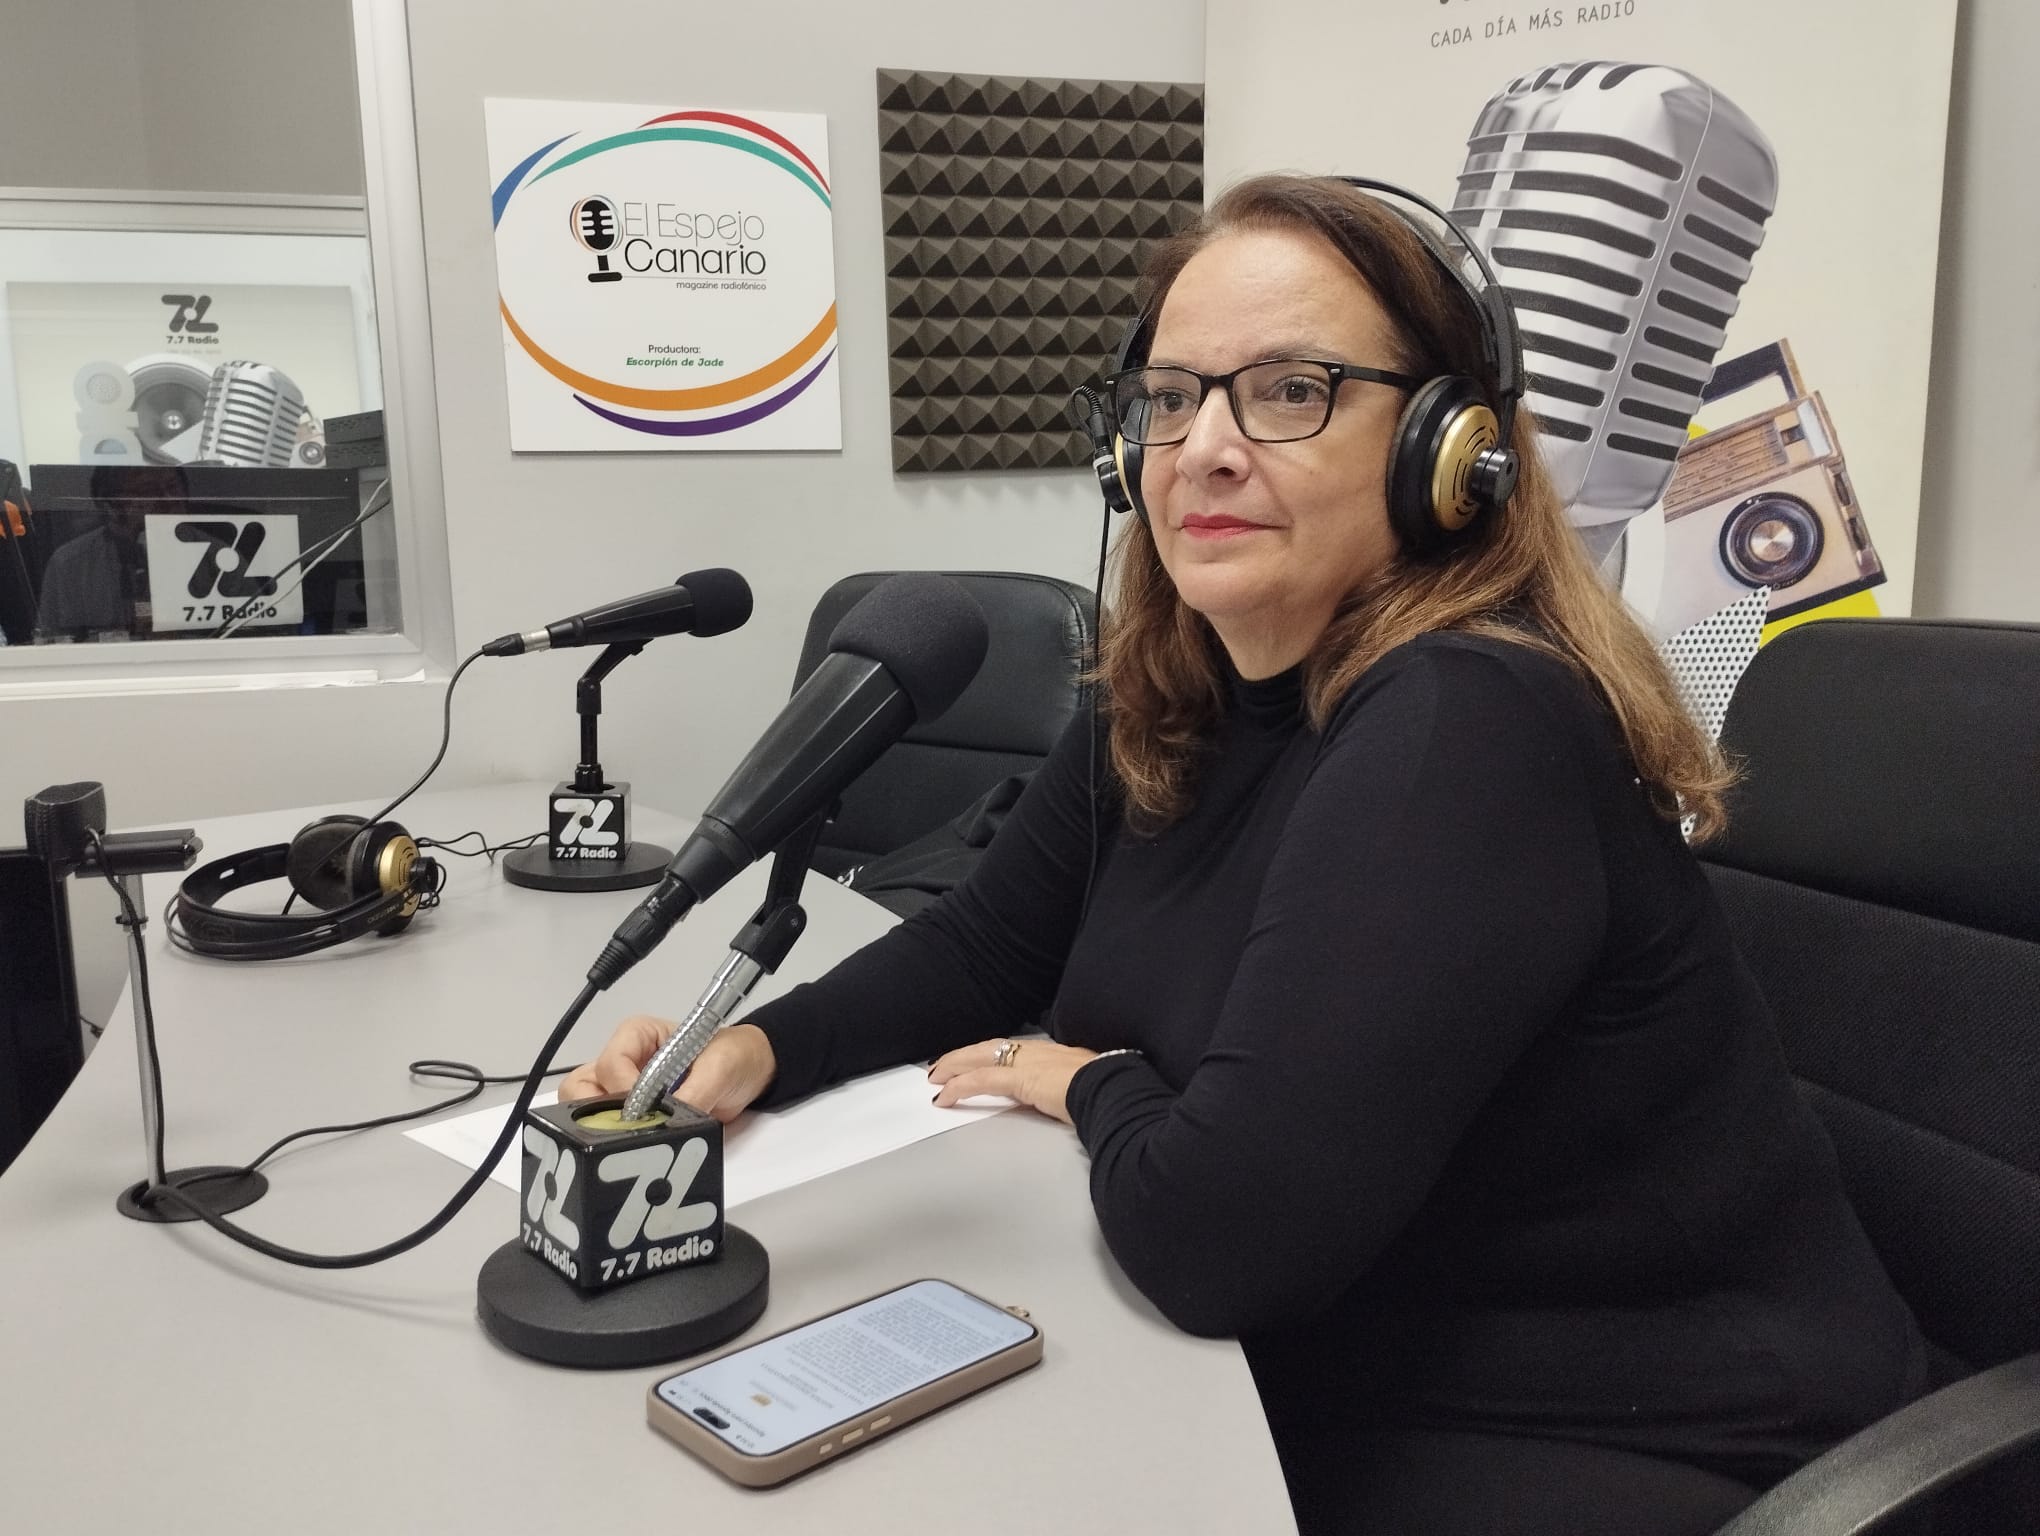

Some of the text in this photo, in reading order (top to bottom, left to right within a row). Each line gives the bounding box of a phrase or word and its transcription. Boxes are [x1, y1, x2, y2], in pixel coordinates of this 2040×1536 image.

[1431, 0, 1635, 48] CADA DÍA MÁS RADIO
[624, 202, 765, 247] El Espejo
[624, 238, 767, 275] Canario
[676, 280, 767, 291] magazine radiofónico
[166, 335, 219, 345] 7.7 Radio
[648, 344, 701, 354] Productora:
[626, 356, 725, 368] Escorpión de Jade
[182, 602, 277, 622] 7.7 Radio
[555, 847, 617, 859] 7.7 Radio
[523, 1222, 578, 1281] 7.7 Radio
[600, 1235, 715, 1282] 7.7 Radio
